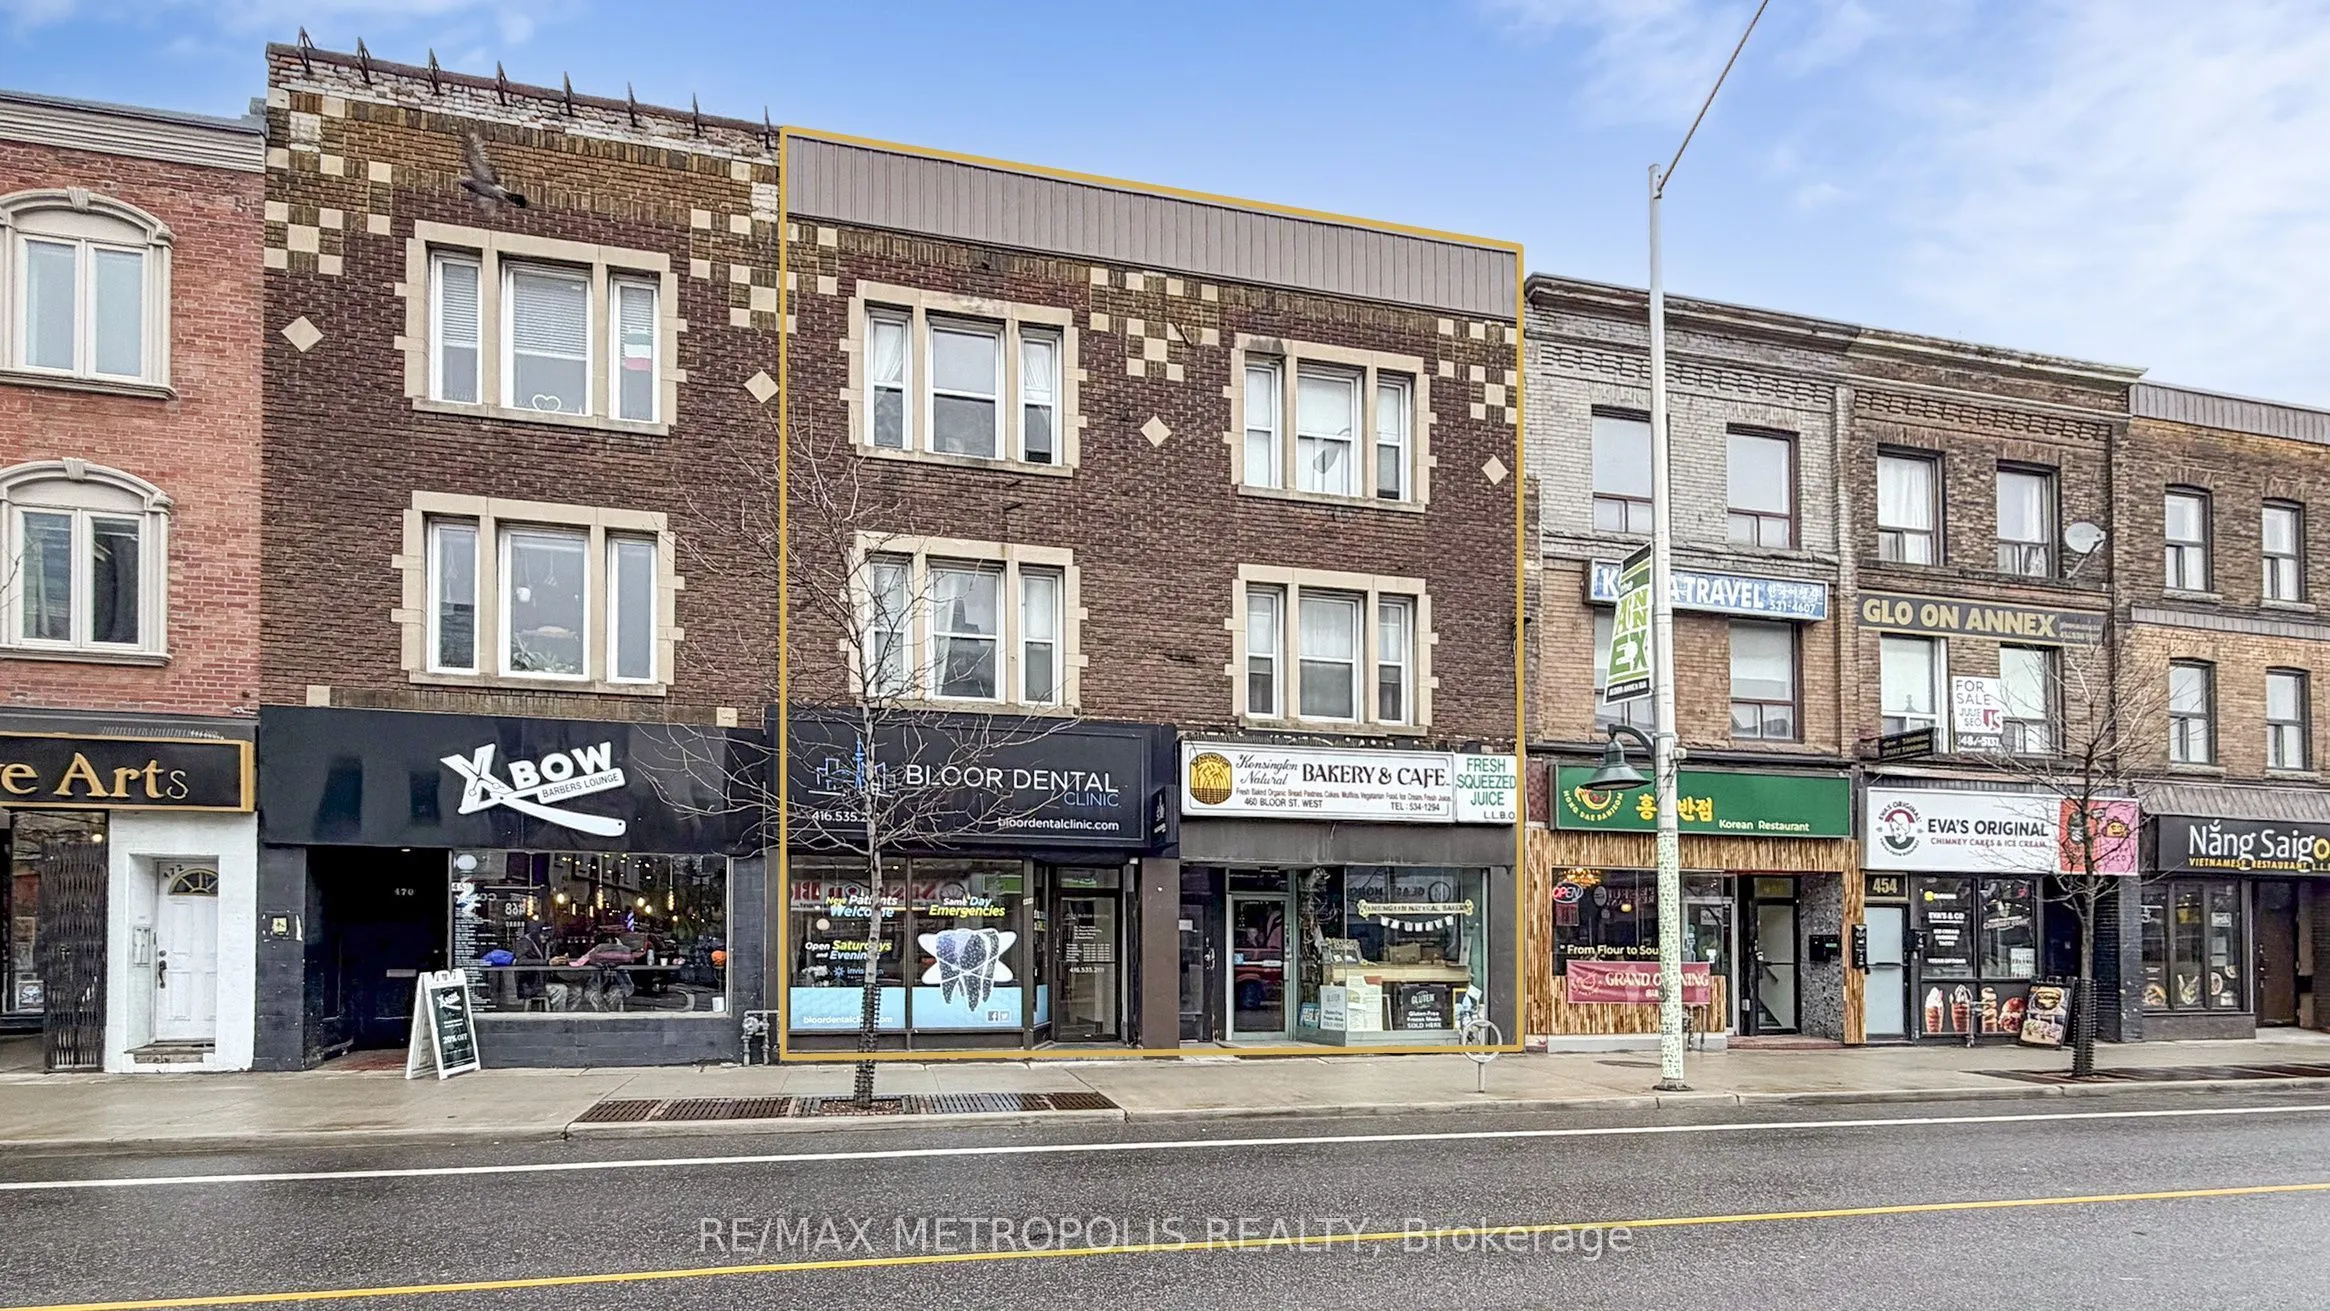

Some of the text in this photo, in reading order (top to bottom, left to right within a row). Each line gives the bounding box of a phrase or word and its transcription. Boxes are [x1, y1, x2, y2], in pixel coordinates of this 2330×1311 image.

[1684, 576, 1764, 609] TRAVEL
[1769, 600, 1815, 614] 531-4607
[1862, 598, 1913, 625] GLO
[1919, 603, 1960, 629] ON
[1965, 607, 2056, 637] ANNEX
[1956, 680, 1985, 692] FOR
[1956, 693, 1991, 705] SALE
[1466, 758, 1506, 772] FRESH
[53, 751, 188, 800] Arts
[906, 764, 1119, 793] BLOOR DENTAL
[1239, 771, 1289, 786] Natural
[1302, 764, 1375, 784] BAKERY
[1378, 767, 1392, 785] &
[1457, 774, 1517, 789] SQUEEZED
[541, 772, 620, 799] BARBERS LOUNGE
[1259, 798, 1287, 808] BLOOR
[1302, 800, 1323, 808] WEST
[1470, 791, 1505, 806] JUICE
[1636, 793, 1713, 822] 홍반점
[998, 817, 1119, 831] bloordentalclinic.com
[1718, 819, 1810, 832] Korean Restaurant
[1927, 818, 2049, 837] EVA'S ORIGINAL
[1930, 837, 1967, 846] CHIMNEY
[1969, 838, 1995, 848] CAKES
[2004, 839, 2017, 847] ICE
[2018, 839, 2047, 848] CREAM
[2189, 819, 2256, 870] Nắng
[2189, 857, 2247, 868] VIETNAMESE
[2251, 860, 2308, 870] RESTAURANT
[1552, 886, 1580, 899] OPEN
[1872, 877, 1898, 894] 454
[969, 896, 993, 907] Day
[929, 904, 1006, 918] Emergencies
[805, 941, 831, 951] Open
[1567, 944, 1596, 955] From
[1597, 944, 1624, 955] Flour
[1626, 945, 1639, 955] to
[1639, 944, 1659, 955] Sou
[1605, 971, 1651, 987] GRAND
[1652, 972, 1709, 987] ONING
